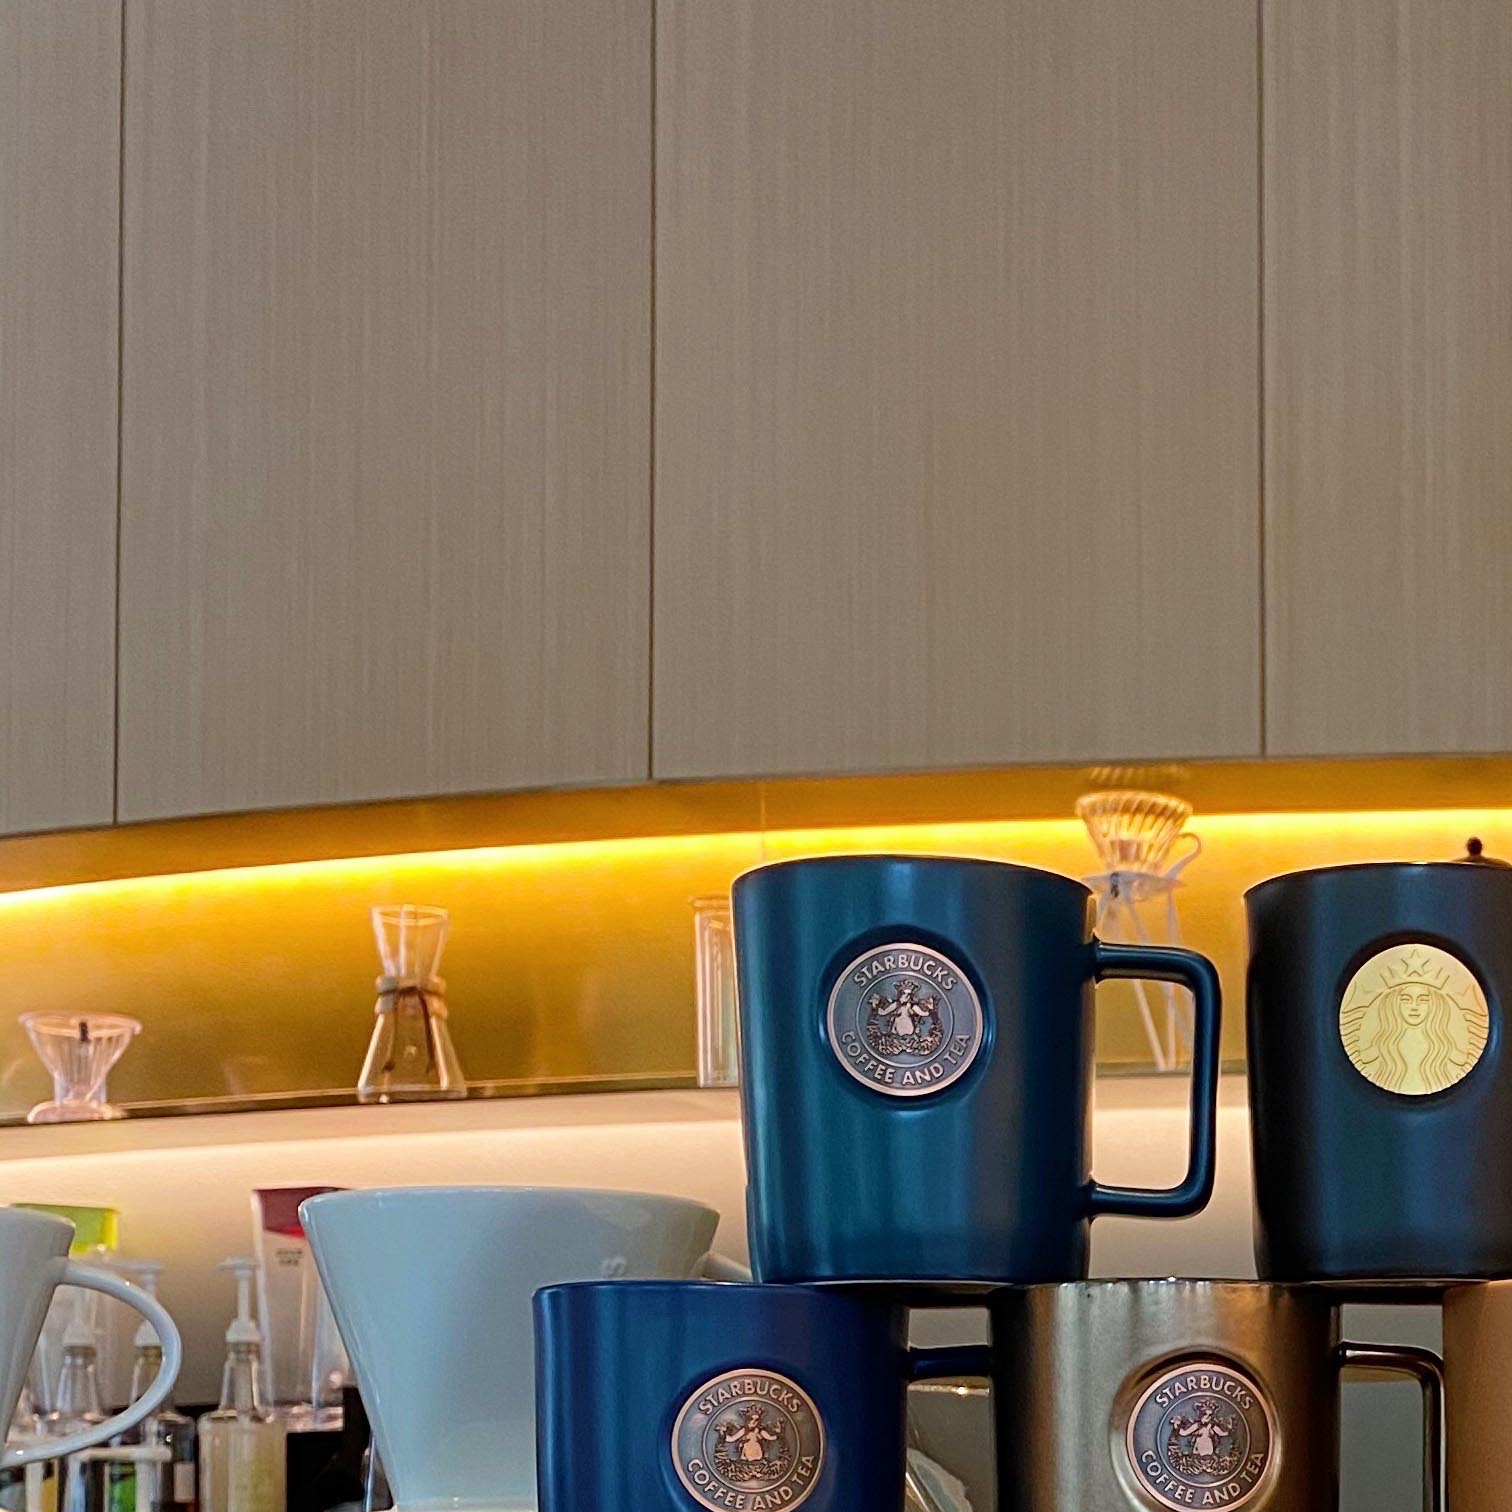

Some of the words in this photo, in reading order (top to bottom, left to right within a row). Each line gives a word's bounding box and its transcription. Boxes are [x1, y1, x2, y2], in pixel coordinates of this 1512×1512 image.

[853, 953, 959, 991] STARBUCKS
[841, 1033, 895, 1084] COFFEE
[902, 1061, 943, 1085] AND
[944, 1033, 972, 1066] TEA
[698, 1380, 803, 1415] STARBUCKS
[1154, 1374, 1254, 1409] STARBUCKS
[687, 1457, 744, 1510] COFFEE
[751, 1485, 793, 1510] AND
[793, 1455, 816, 1490] TEA
[1141, 1450, 1194, 1505] COFFEE
[1201, 1485, 1242, 1509] AND
[1242, 1452, 1265, 1483] TEA
